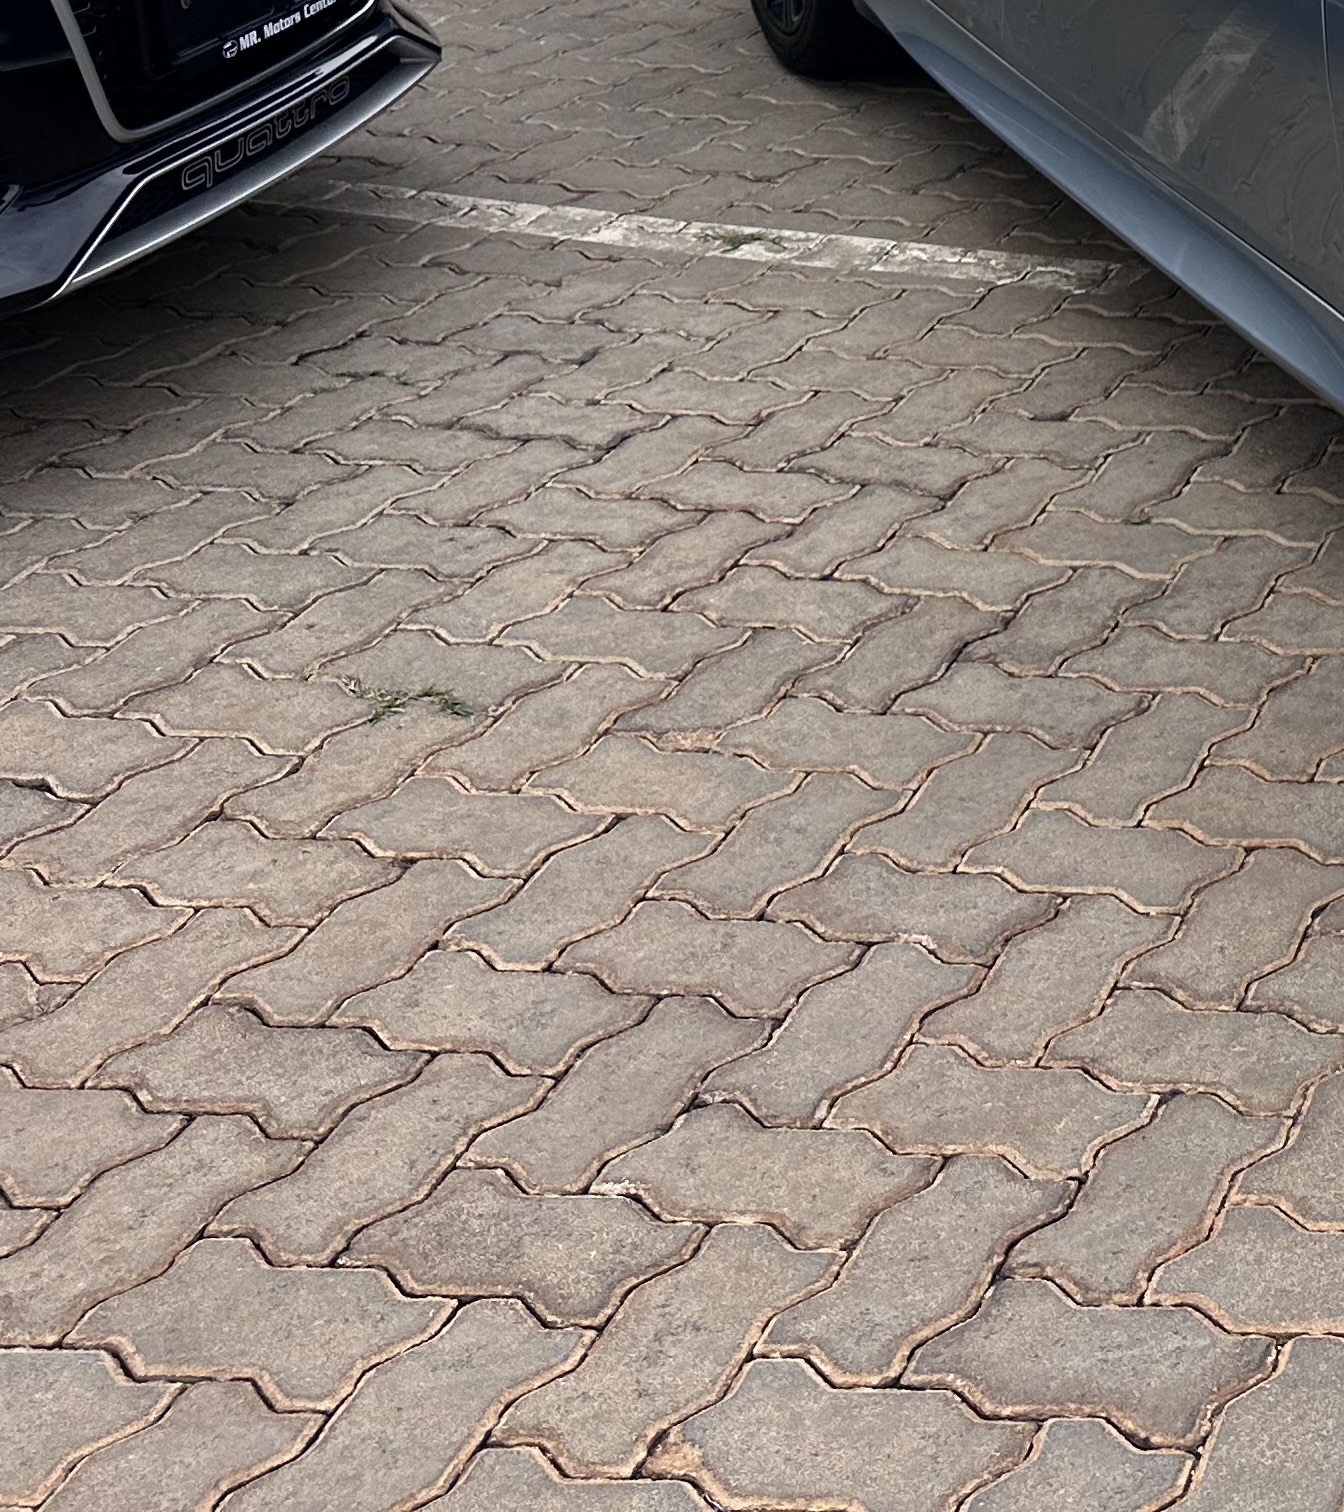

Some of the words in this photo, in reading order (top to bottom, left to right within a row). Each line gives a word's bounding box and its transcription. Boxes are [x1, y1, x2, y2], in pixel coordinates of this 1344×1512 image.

[239, 30, 261, 52] MR.
[263, 11, 301, 39] Motors
[181, 75, 350, 191] quattro
